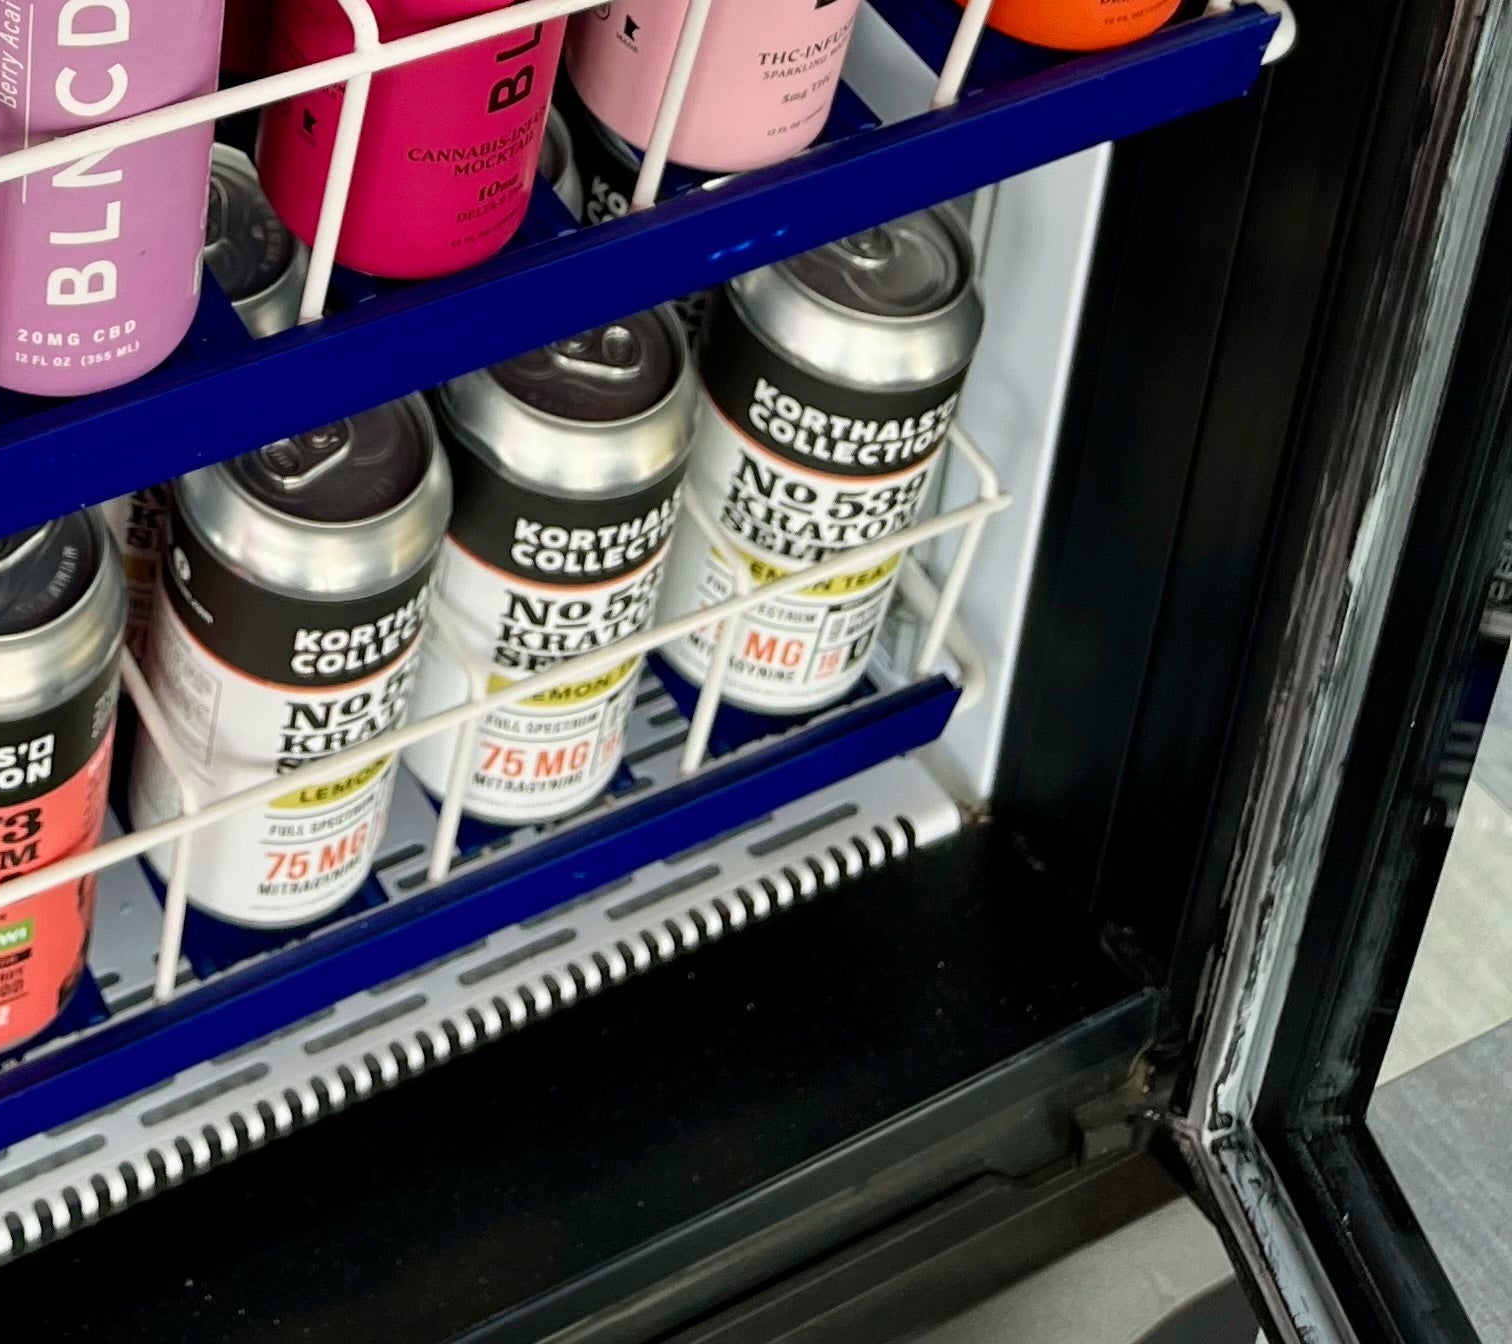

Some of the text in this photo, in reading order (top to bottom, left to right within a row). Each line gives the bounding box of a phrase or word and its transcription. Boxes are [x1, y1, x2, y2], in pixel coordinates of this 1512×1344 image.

[17, 319, 136, 347] 20MG CBD
[15, 340, 140, 367] 12 FL OZ (355 ML)
[743, 632, 807, 668] MG
[480, 740, 589, 778] 75 MG
[264, 850, 311, 881] 75
